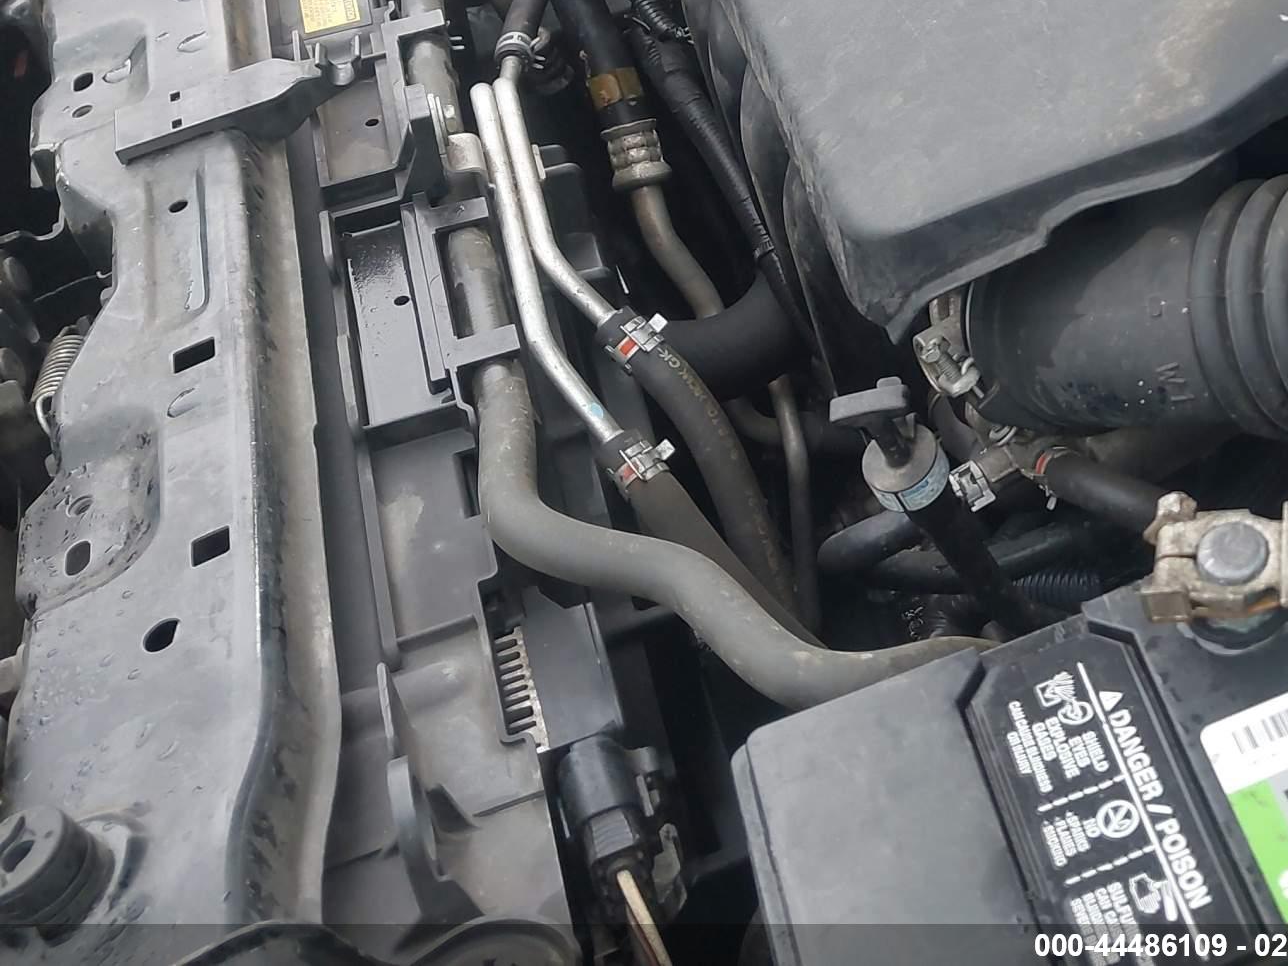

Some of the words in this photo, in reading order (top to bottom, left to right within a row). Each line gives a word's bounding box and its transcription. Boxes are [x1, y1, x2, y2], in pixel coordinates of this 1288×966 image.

[1032, 722, 1057, 762] GASES
[1045, 717, 1081, 779] EXPLOSIVE
[1069, 736, 1091, 768] EYES
[1082, 731, 1109, 772] SHIELD
[1082, 818, 1100, 838] NO
[1108, 709, 1163, 801] DANGER
[1155, 818, 1212, 909] POISON
[1095, 888, 1113, 910] CAN
